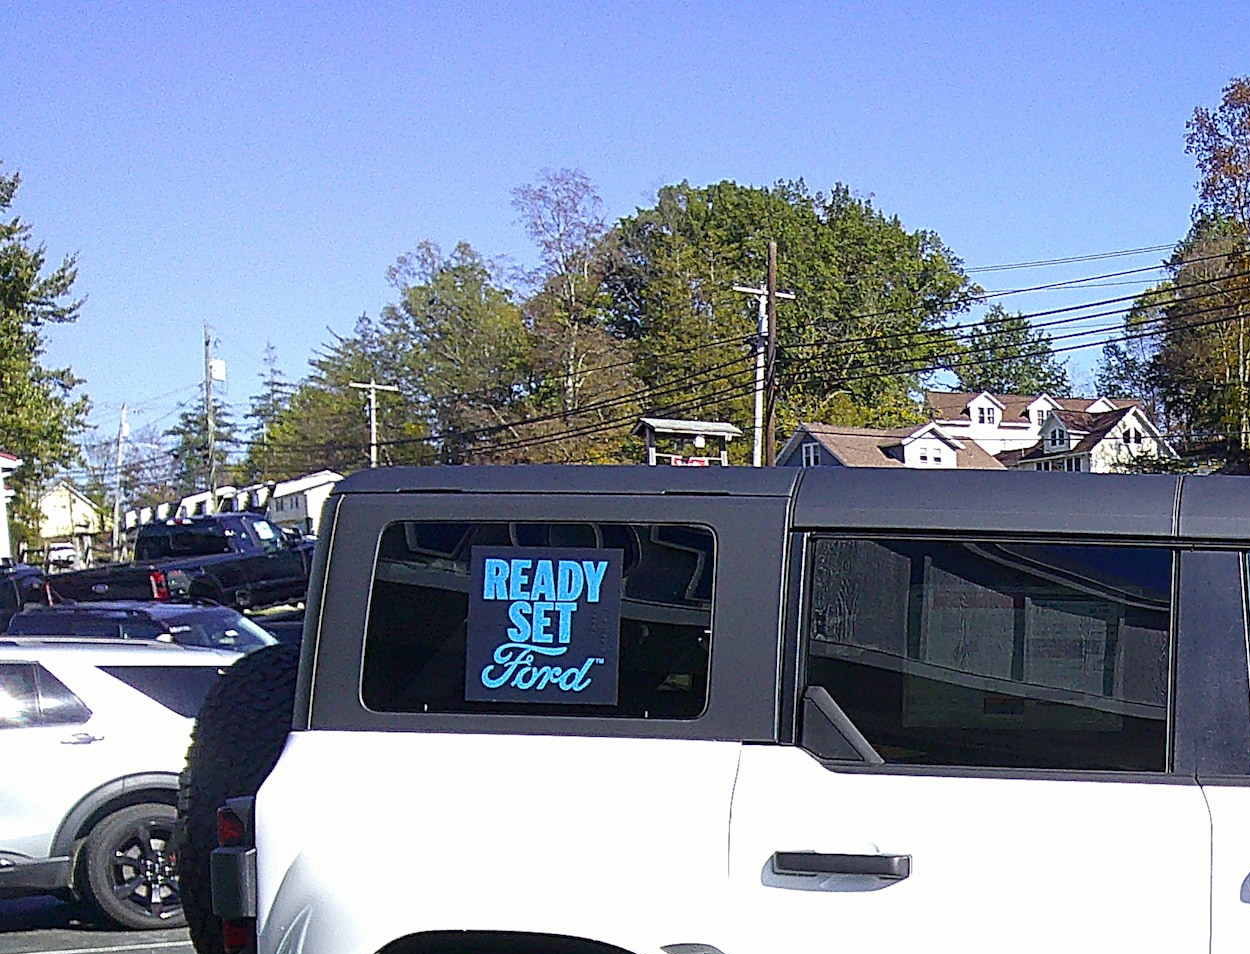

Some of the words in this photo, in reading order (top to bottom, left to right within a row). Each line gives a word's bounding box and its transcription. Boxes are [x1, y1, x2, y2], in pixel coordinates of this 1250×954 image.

[483, 558, 609, 602] READY
[507, 601, 577, 643] SET
[481, 642, 595, 692] Ford
